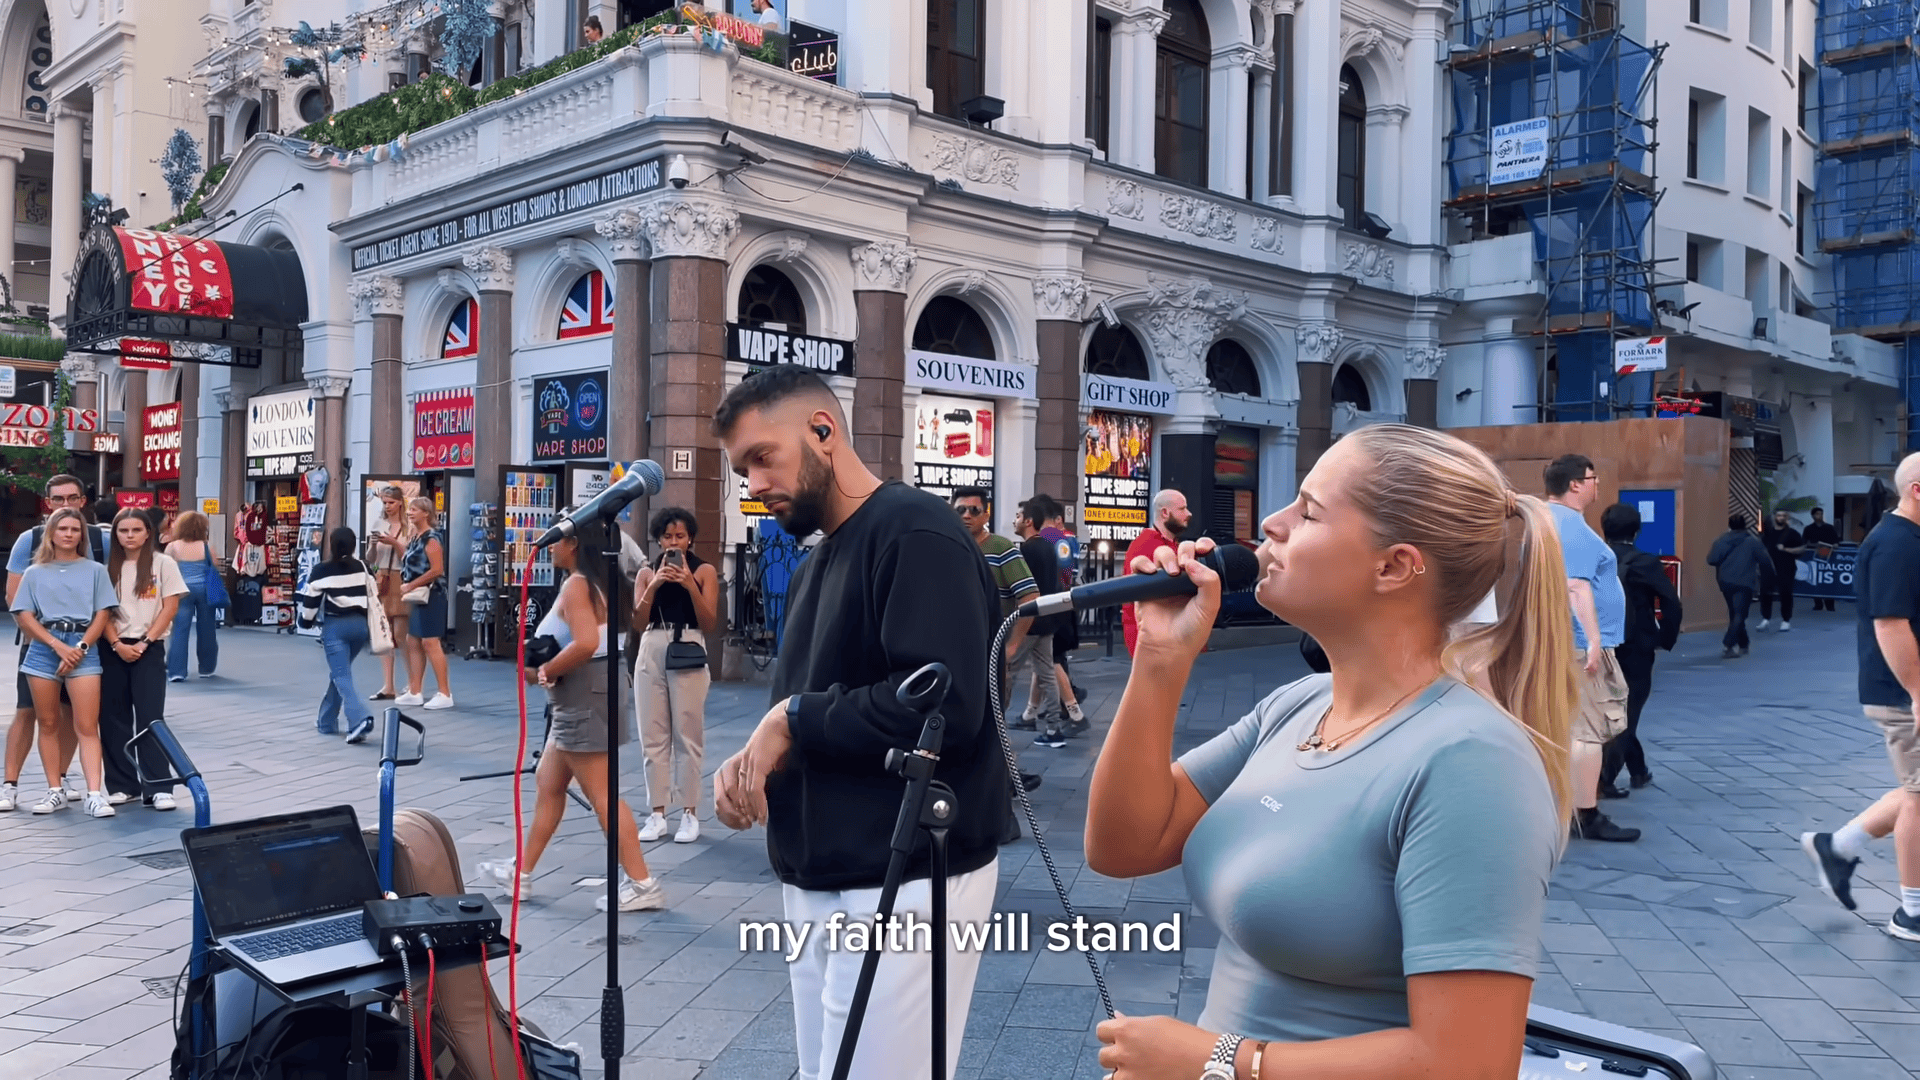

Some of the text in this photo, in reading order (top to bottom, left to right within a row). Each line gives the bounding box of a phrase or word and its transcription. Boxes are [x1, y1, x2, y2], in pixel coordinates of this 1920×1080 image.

[715, 15, 763, 46] BALCONY
[792, 44, 837, 73] club
[1495, 120, 1546, 136] ALARMED
[354, 247, 379, 270] OFFICIAL
[378, 240, 400, 262] TICKET
[400, 235, 420, 256] AGENT
[420, 229, 439, 251] SINCE
[441, 222, 458, 244] 1970
[464, 216, 477, 238] FOR
[478, 211, 491, 232] ALL
[491, 206, 511, 230] WEST
[513, 202, 528, 223] END
[529, 192, 557, 220] SHOWS
[558, 190, 566, 212] &
[567, 178, 599, 210] LONDON
[601, 160, 660, 201] ATTRACTIONS
[99, 229, 121, 285] HOUSE
[125, 229, 167, 307] ONEY
[161, 233, 194, 310] CHANGE
[739, 328, 844, 371] VAPE SHOP
[1618, 347, 1663, 357] FORMARK
[916, 358, 1026, 390] SOUVENIRS
[1087, 382, 1170, 408] GIFT SHOP
[150, 408, 178, 428] MONEY
[259, 399, 304, 424] LONDON
[416, 405, 473, 437] ICE CREAM
[547, 411, 562, 419] VAPE
[252, 425, 314, 450] SOUVENIRS
[535, 437, 606, 457] VAPE SHOP
[146, 456, 152, 472] £
[155, 454, 161, 474] $
[264, 457, 279, 476] VAPE
[280, 455, 297, 475] SHOP
[675, 452, 689, 470] H
[921, 466, 978, 487] VAPE SHOP
[1090, 477, 1113, 495] VAPE
[1113, 478, 1137, 496] SHOP
[1108, 511, 1146, 521] EXCHANGE
[1087, 525, 1144, 540] EATRE TICKET
[1818, 571, 1834, 584] IS
